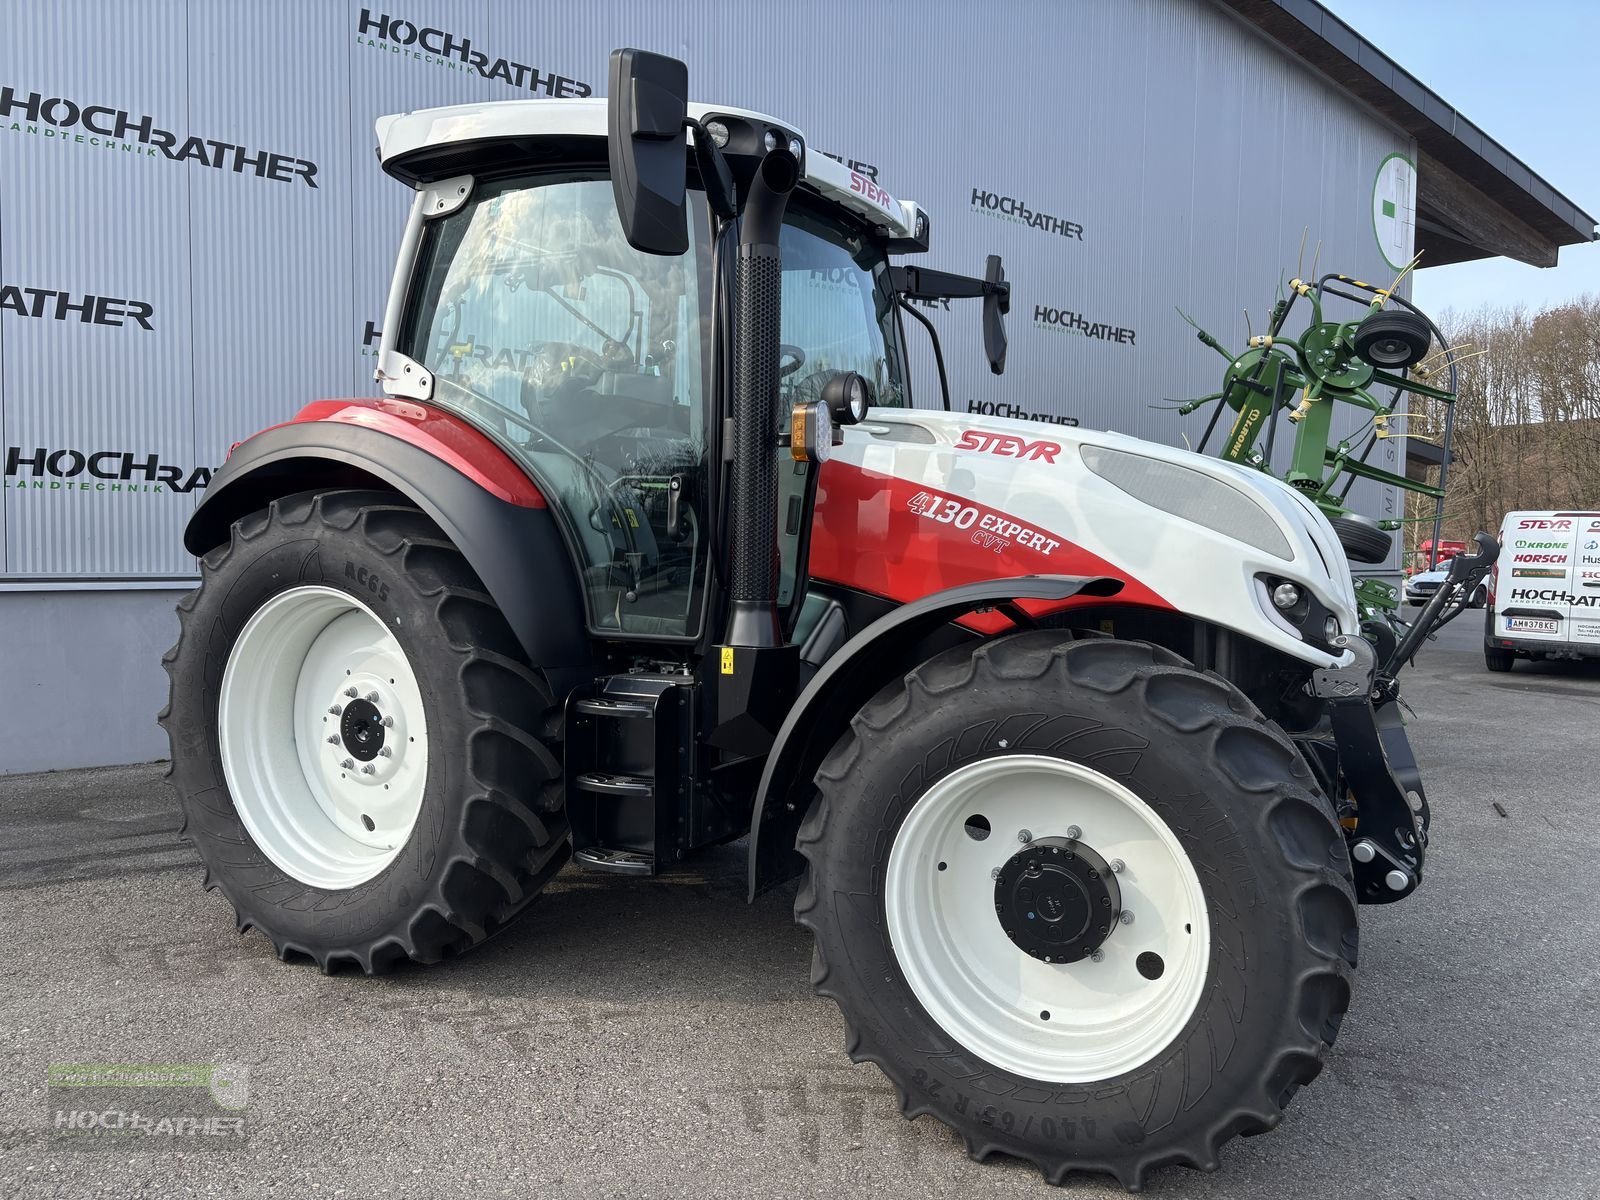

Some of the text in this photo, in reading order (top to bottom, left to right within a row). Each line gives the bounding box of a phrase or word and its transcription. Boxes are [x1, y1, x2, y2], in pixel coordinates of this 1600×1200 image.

[357, 36, 474, 75] LANDTECHNIK
[358, 8, 592, 98] HOCHRATHER
[0, 86, 319, 189] HOCHRATHER
[850, 171, 891, 210] STEYR
[970, 207, 1026, 226] LANDTECHNIK
[971, 188, 1084, 241] HOCHRATHER
[1034, 305, 1136, 346] HOCHRATHER
[954, 429, 1062, 465] STEYR
[1230, 419, 1254, 459] KRONE
[3, 480, 163, 494] LANDTECHNIK
[907, 491, 1061, 556] 4130 EXPERT
[971, 529, 1011, 554] CVT
[1517, 520, 1572, 529] STEYR
[1513, 554, 1568, 563] HORSCH
[344, 560, 391, 603] AC65
[911, 1067, 945, 1098] 28
[980, 1104, 1097, 1141] 440/65
